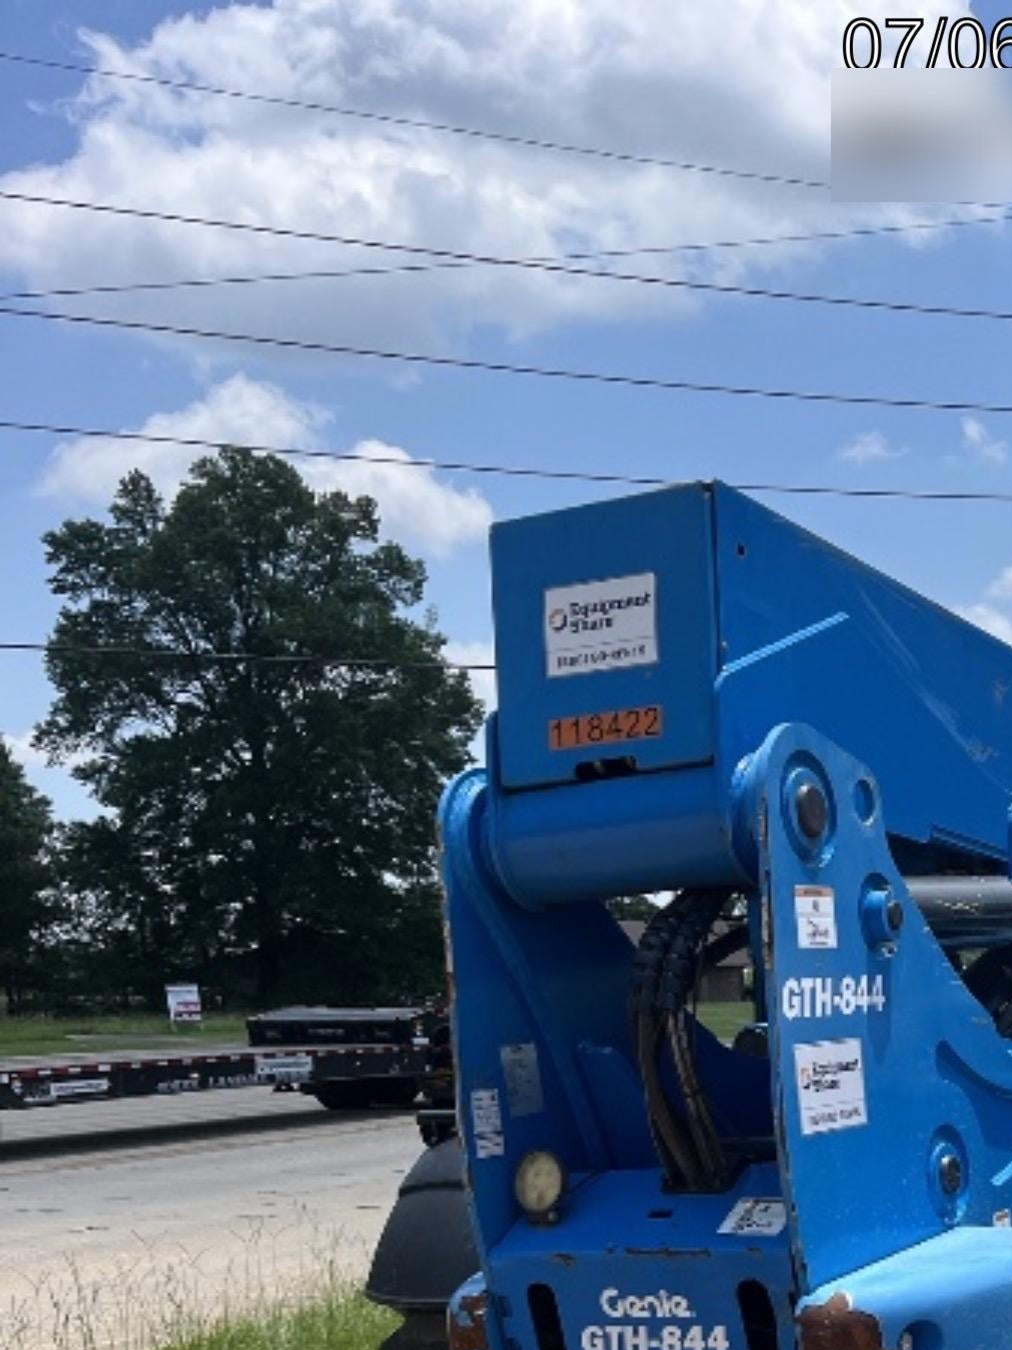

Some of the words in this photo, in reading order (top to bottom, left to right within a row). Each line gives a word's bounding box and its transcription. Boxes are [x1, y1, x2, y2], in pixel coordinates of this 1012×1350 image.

[552, 706, 660, 748] 118422
[782, 974, 886, 1021] GTH-844
[599, 1287, 696, 1319] Genie
